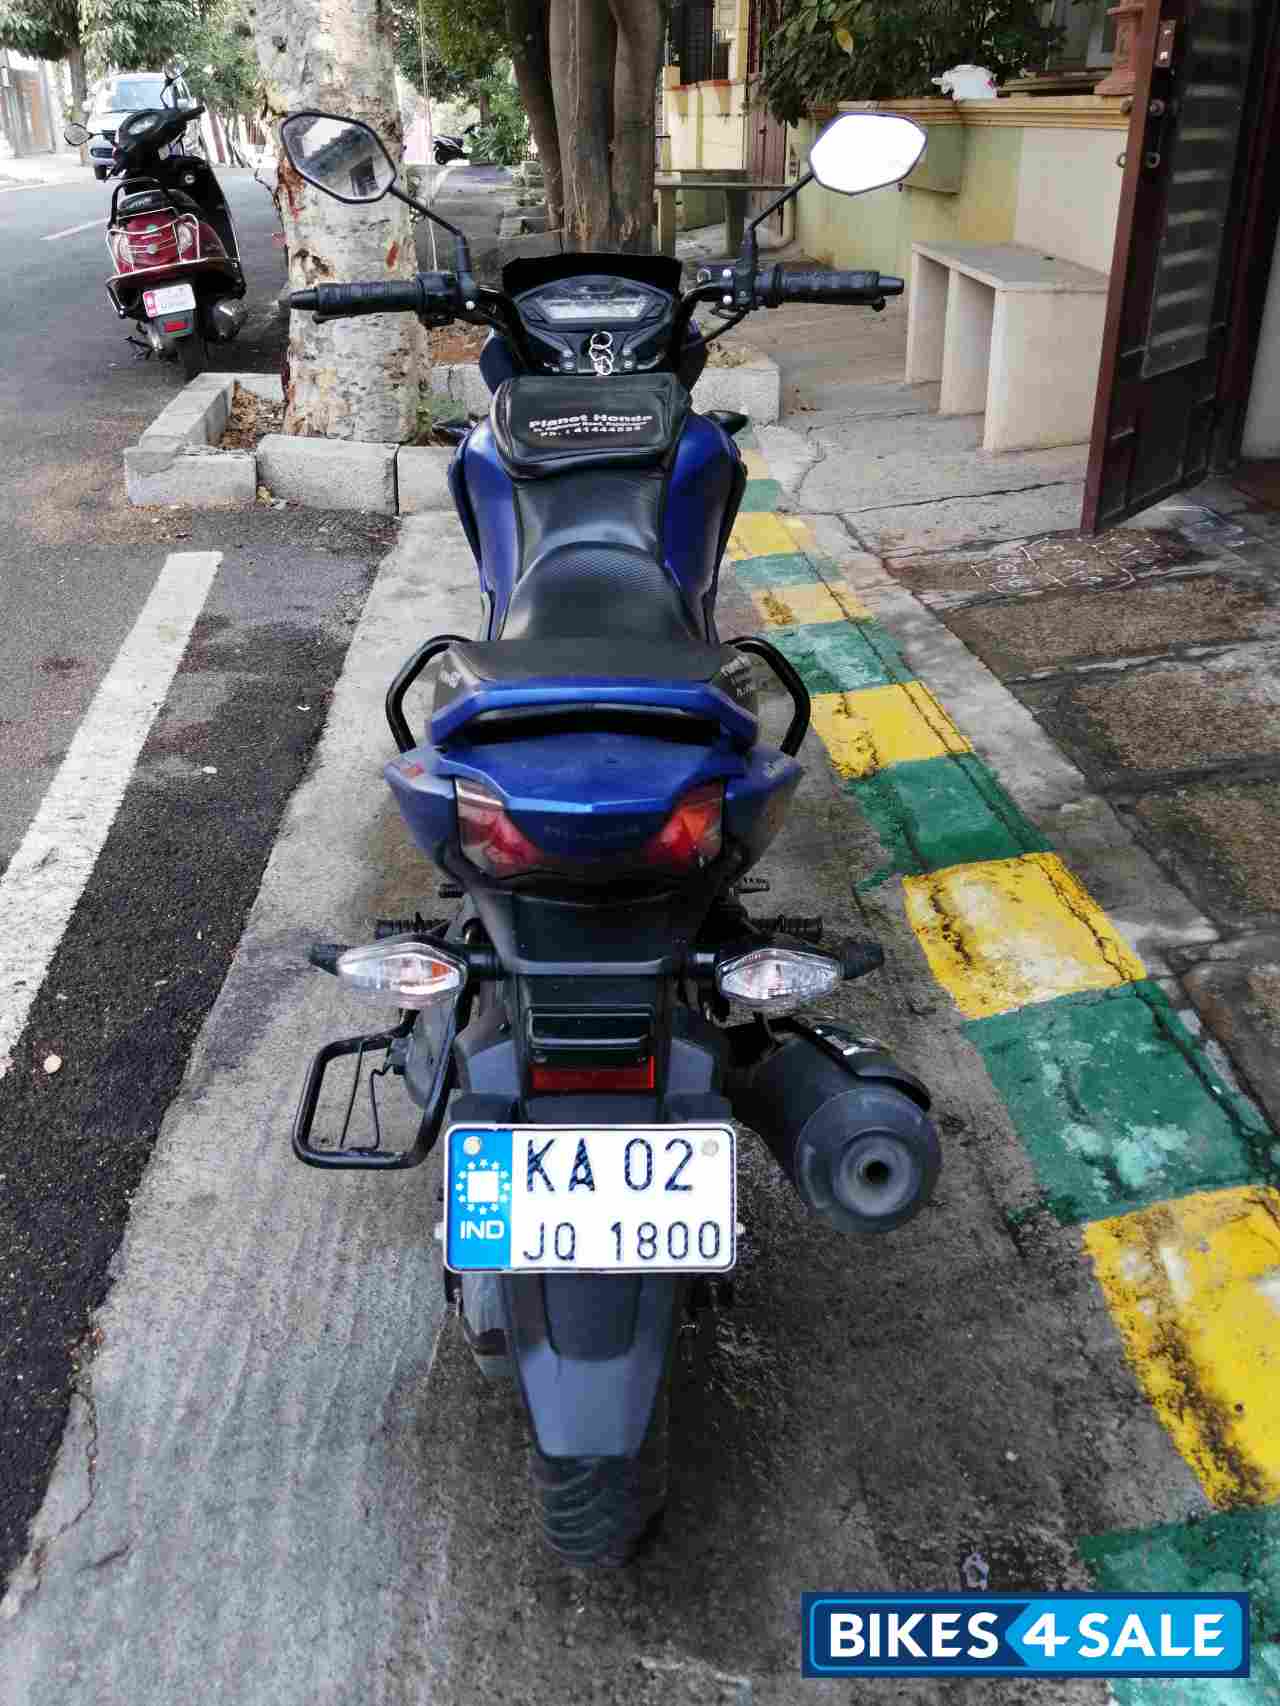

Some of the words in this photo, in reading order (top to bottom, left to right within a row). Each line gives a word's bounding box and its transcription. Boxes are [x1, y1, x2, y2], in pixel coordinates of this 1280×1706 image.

[529, 414, 588, 428] Planet
[593, 414, 653, 422] Honda
[526, 1137, 596, 1192] KA
[623, 1137, 694, 1192] 02
[459, 1220, 505, 1240] IND
[522, 1221, 577, 1261] JQ
[610, 1219, 721, 1260] 1800
